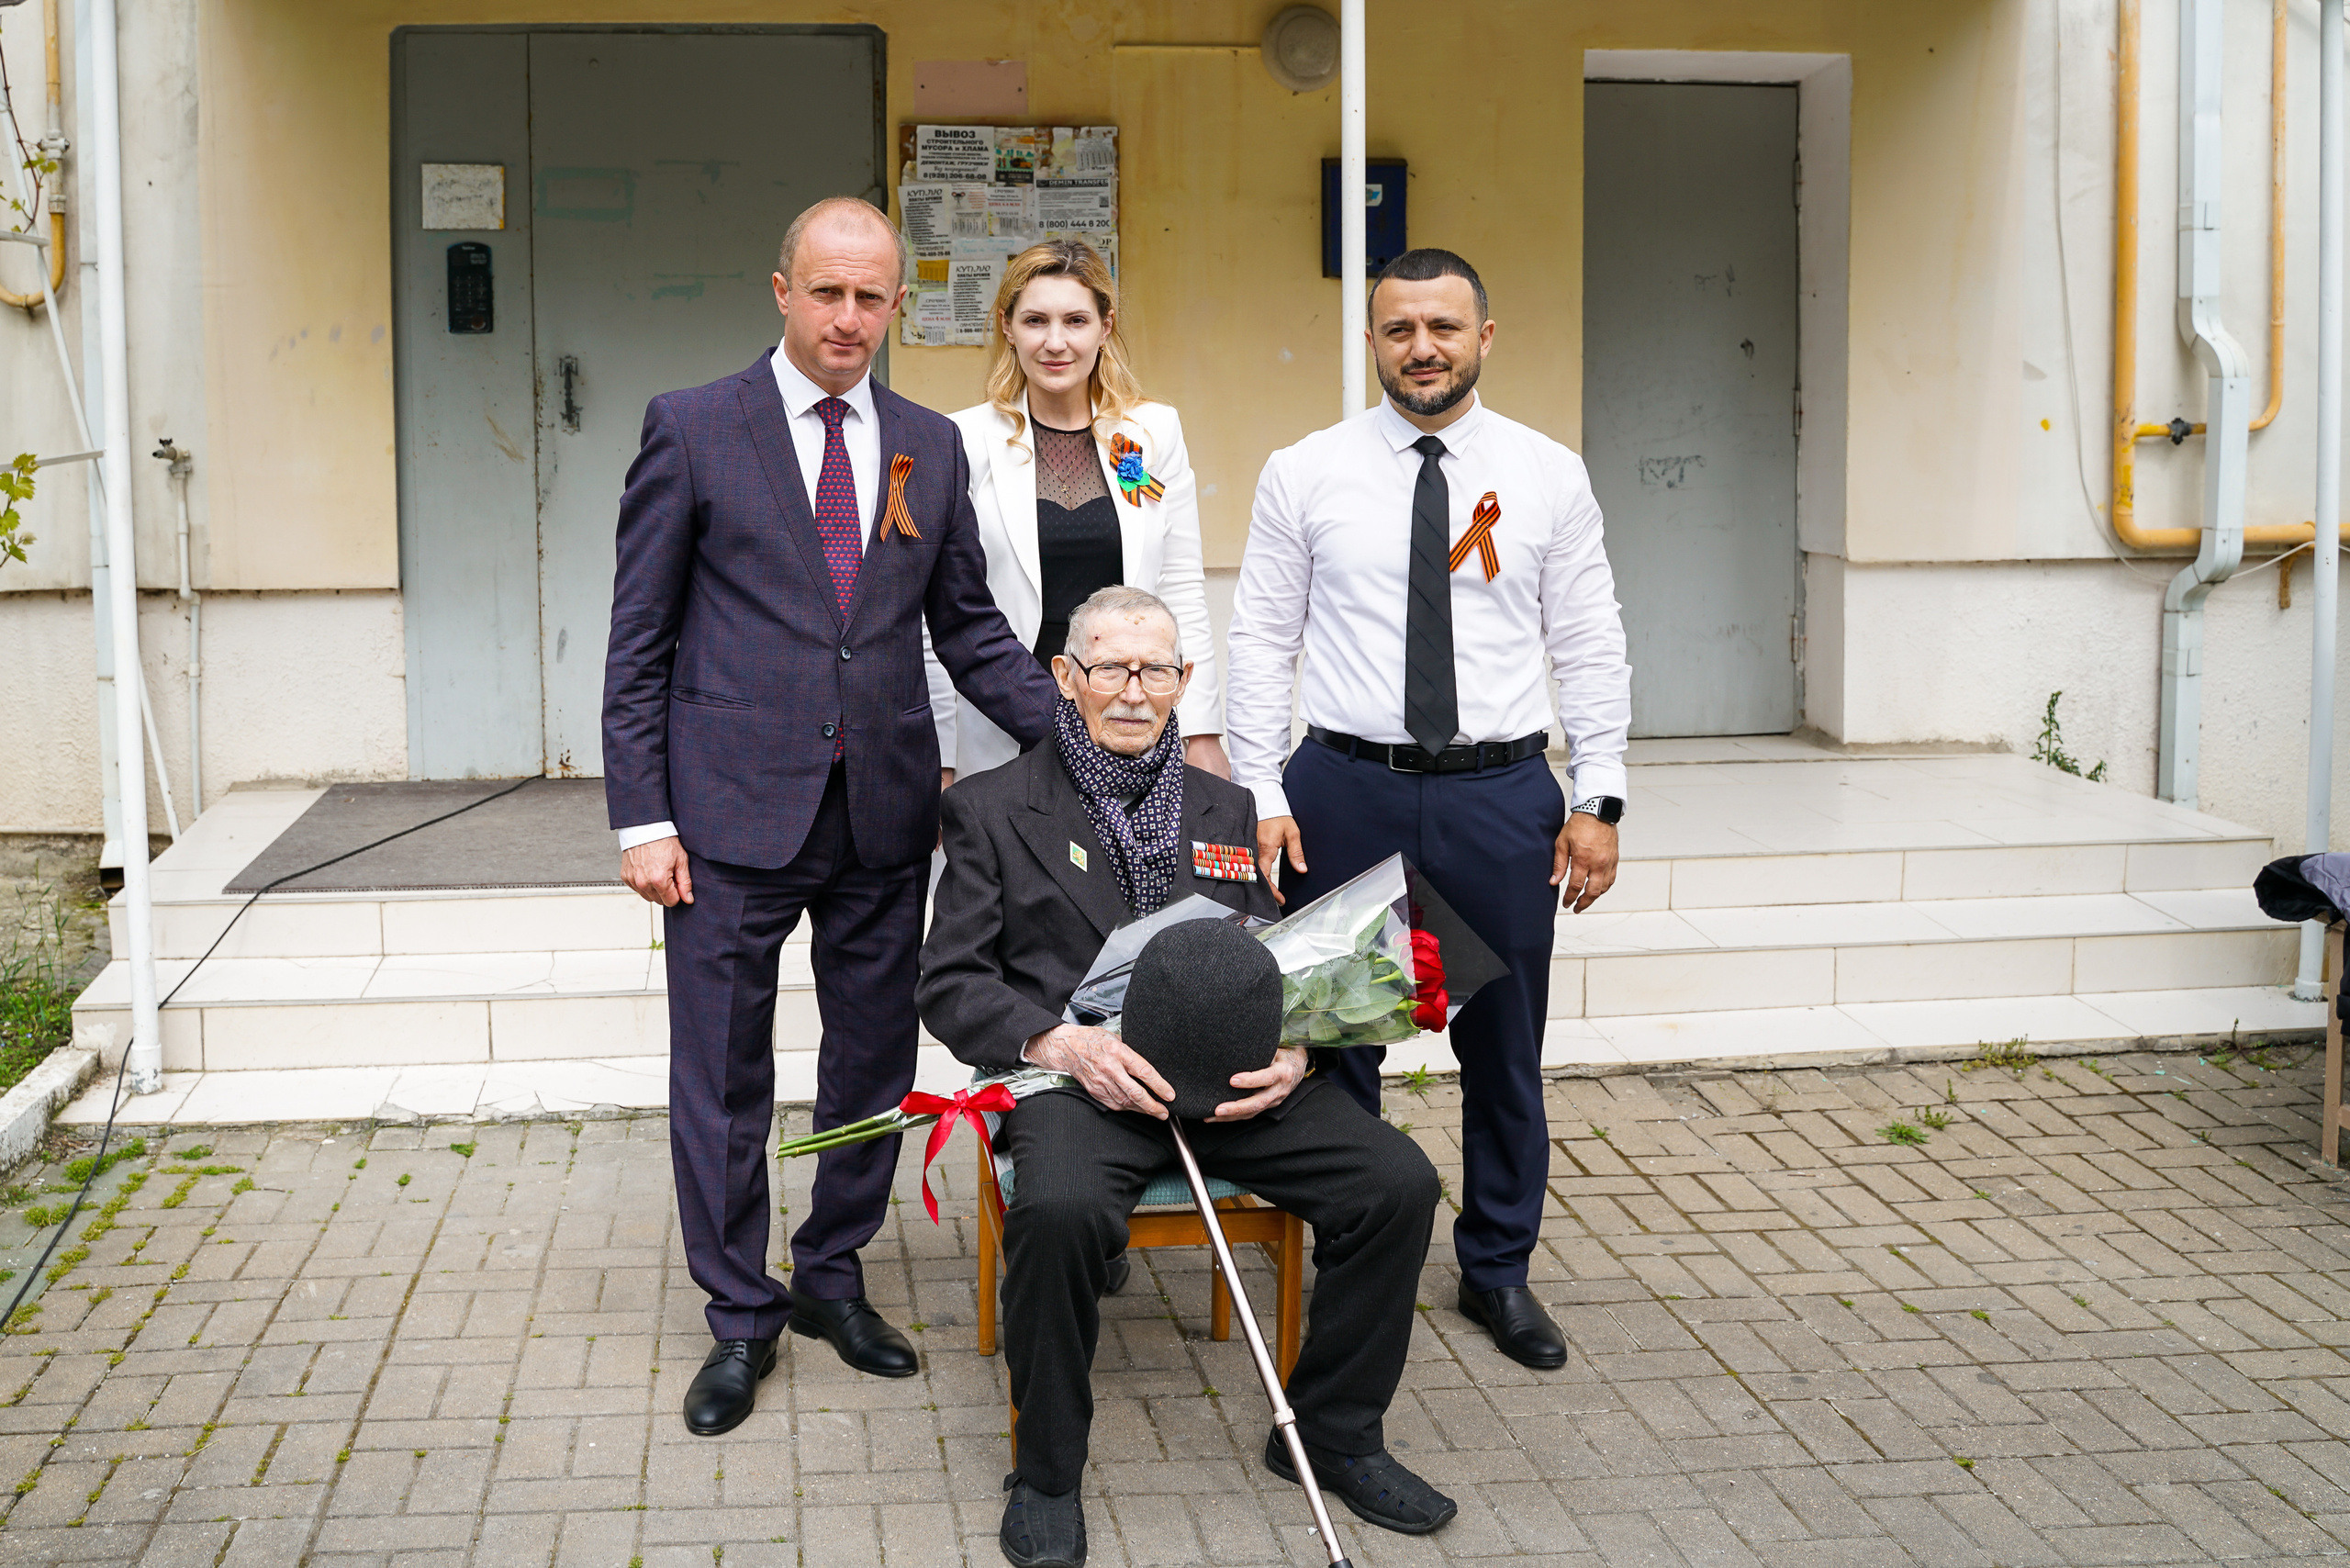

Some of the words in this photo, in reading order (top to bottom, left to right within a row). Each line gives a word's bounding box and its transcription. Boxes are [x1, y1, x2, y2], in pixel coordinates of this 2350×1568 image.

[934, 129, 976, 139] ВЫВОЗ
[1039, 220, 1045, 229] 8
[1046, 220, 1069, 230] (800)
